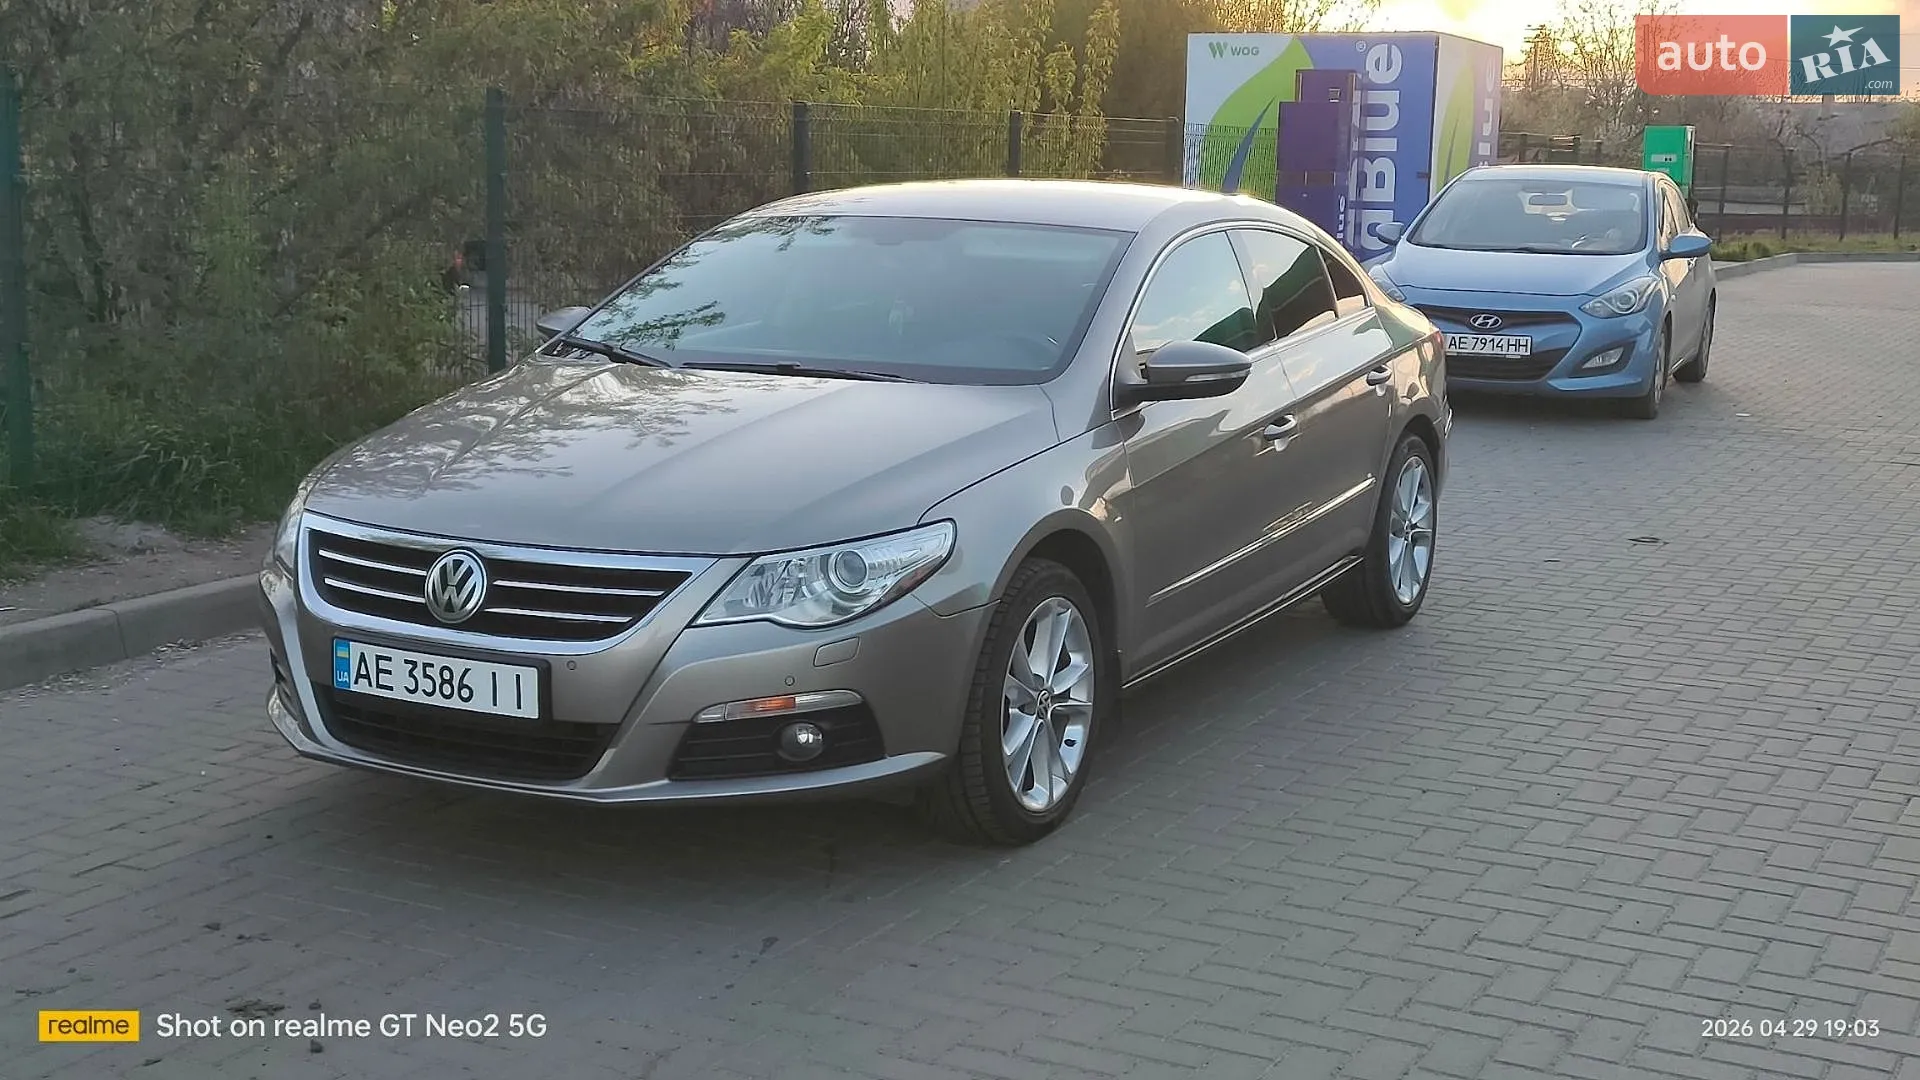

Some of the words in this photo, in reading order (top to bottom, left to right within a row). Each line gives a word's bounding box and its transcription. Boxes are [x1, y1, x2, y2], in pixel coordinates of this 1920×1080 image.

[1230, 46, 1260, 56] WOG
[1448, 336, 1469, 350] AE
[1471, 337, 1504, 352] 7914
[1506, 339, 1529, 353] HH
[337, 670, 349, 683] UA
[353, 651, 394, 692] AE
[403, 658, 475, 703] 3586
